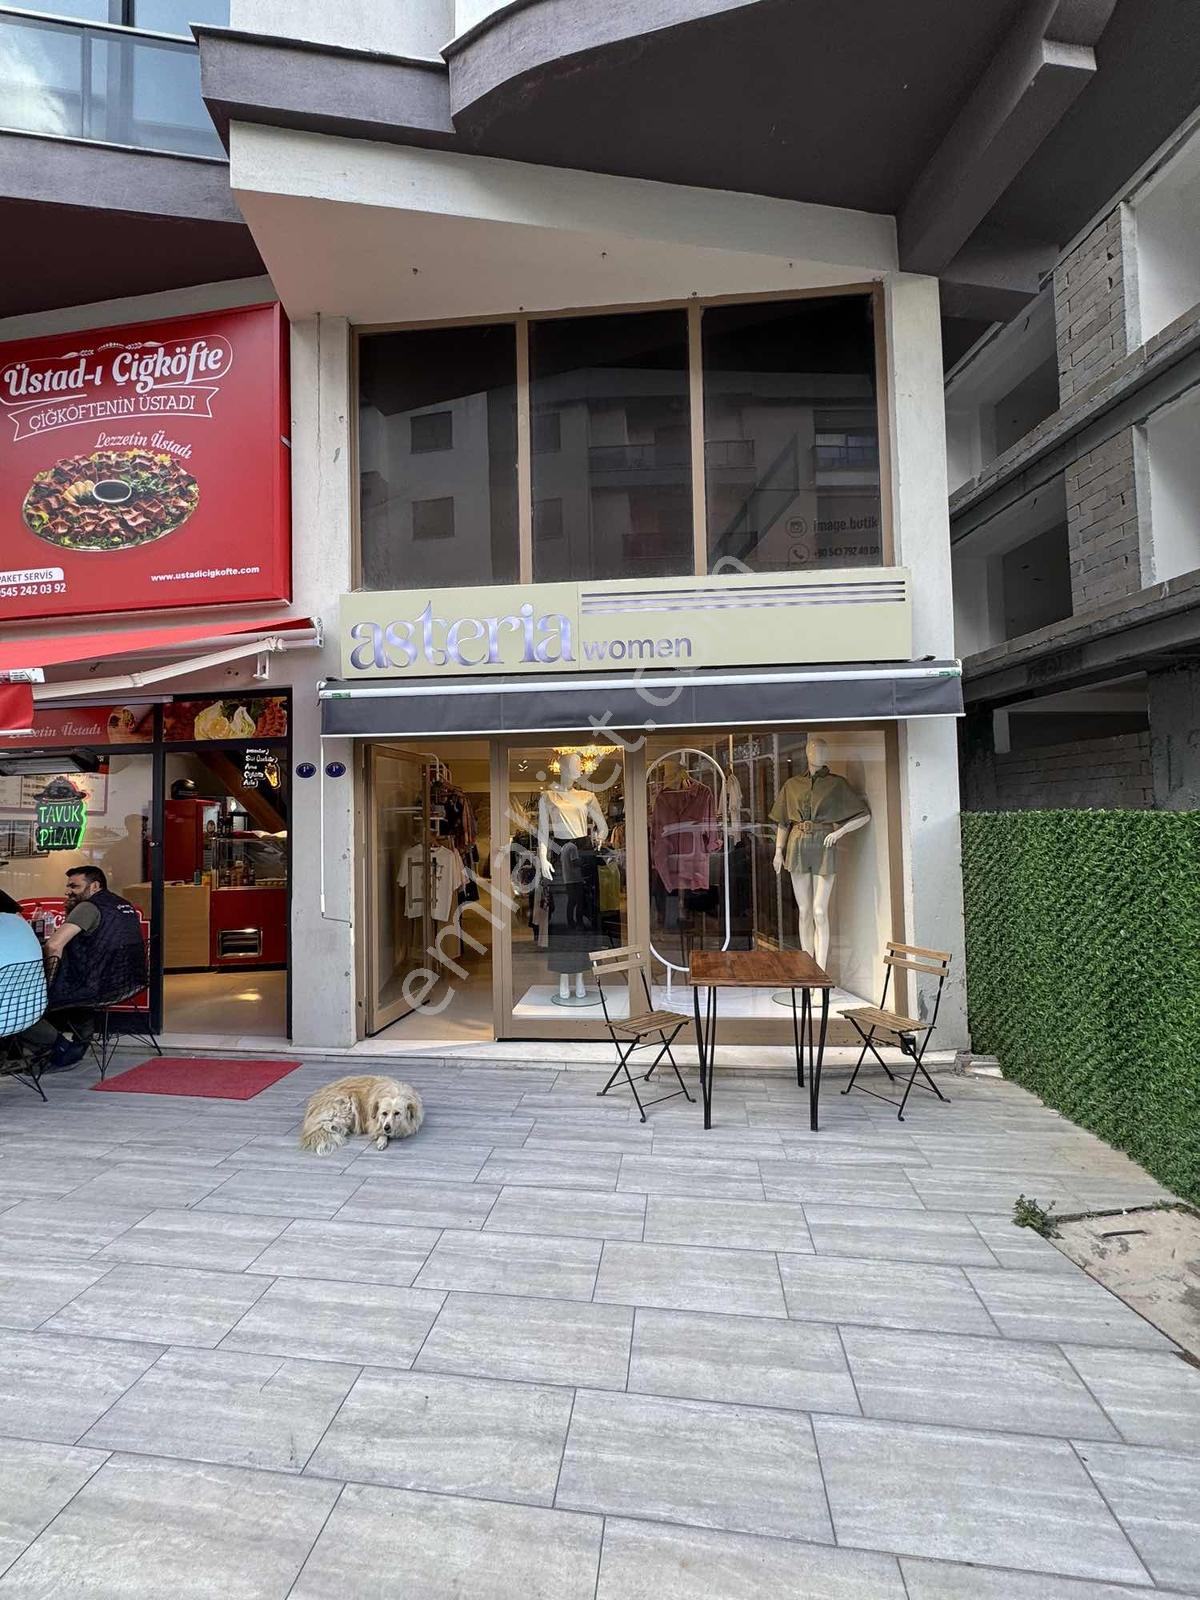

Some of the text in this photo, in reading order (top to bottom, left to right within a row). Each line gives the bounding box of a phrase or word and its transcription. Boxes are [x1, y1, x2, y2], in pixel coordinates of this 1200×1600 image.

[4, 358, 103, 396] Üstad-ı
[139, 394, 195, 411] ÜSTADI
[94, 430, 193, 459] Lezzetin Üstadı
[151, 566, 260, 581] www.ustadicigkofte.com
[0, 582, 67, 598] 545 242 03 92
[350, 600, 693, 670] asteria women
[40, 805, 80, 823] TAVUK
[40, 826, 78, 847] PİLAV
